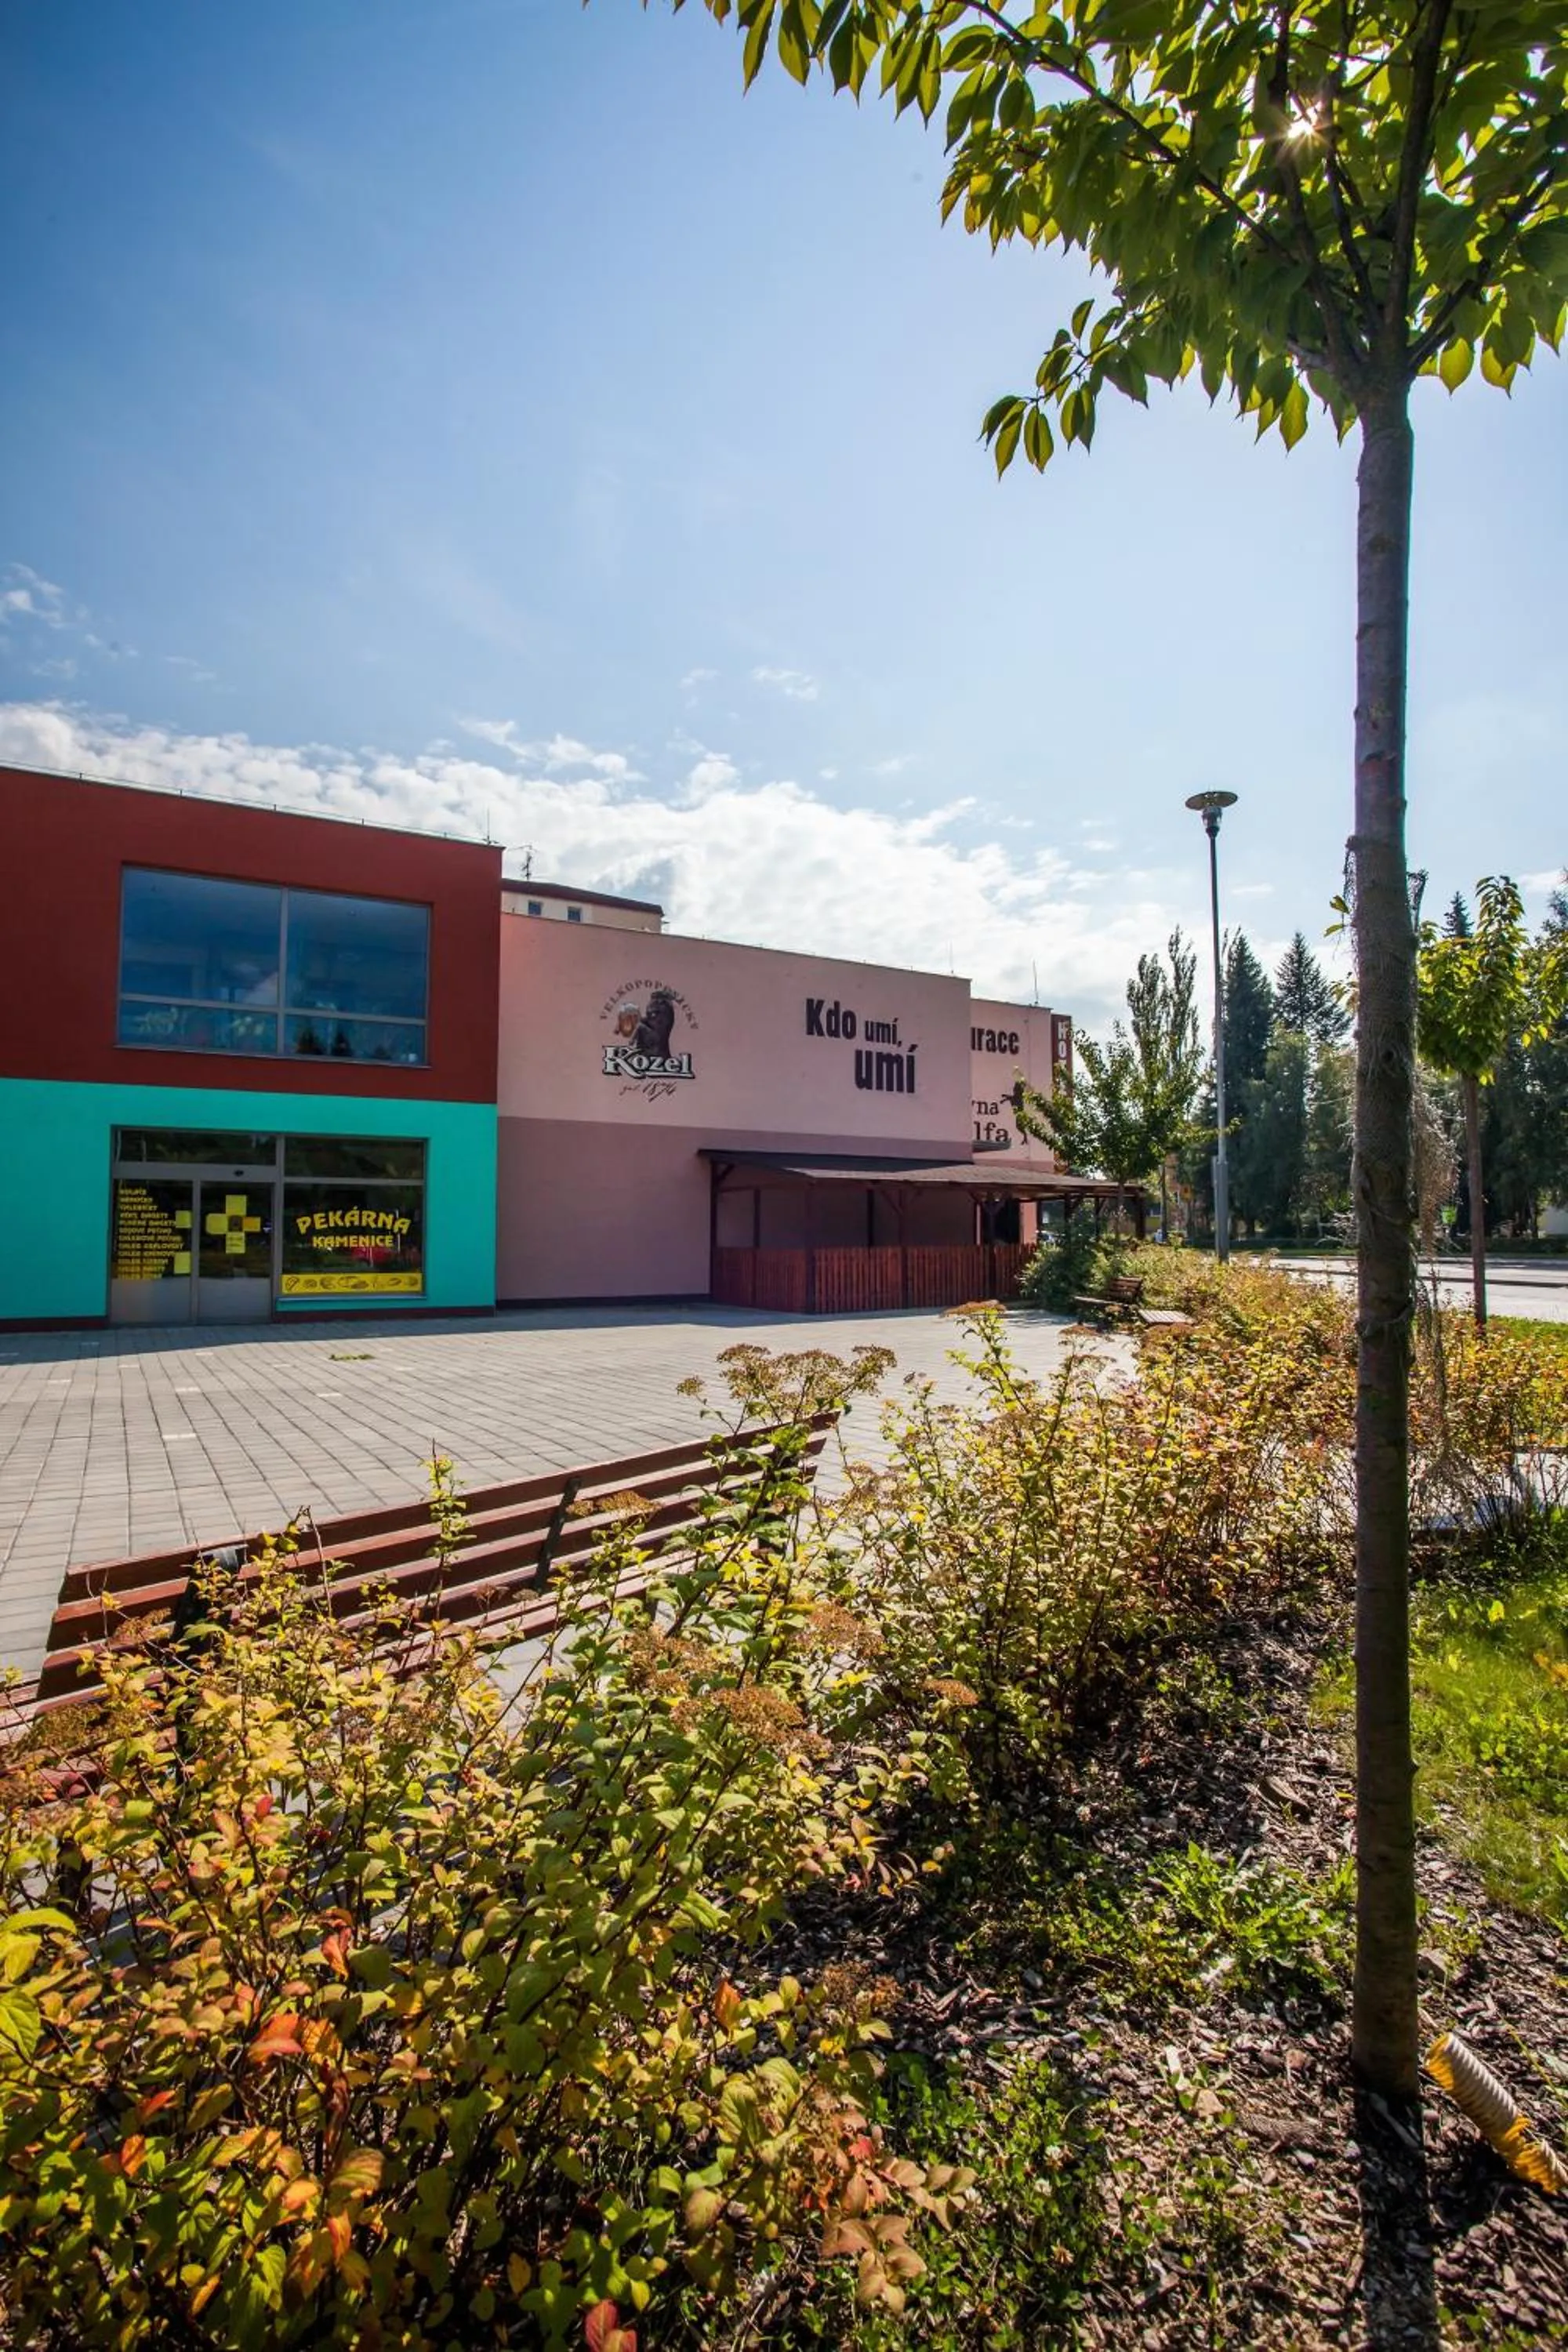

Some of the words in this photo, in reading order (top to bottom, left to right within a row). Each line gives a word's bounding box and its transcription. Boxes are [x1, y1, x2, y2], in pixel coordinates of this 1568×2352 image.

[806, 998, 857, 1040] Kdo
[865, 1018, 902, 1047] umí,
[602, 1045, 695, 1079] Kozel
[855, 1044, 918, 1094] umí
[296, 1205, 412, 1235] PEKÁRNA
[312, 1235, 394, 1248] KAMENICE
